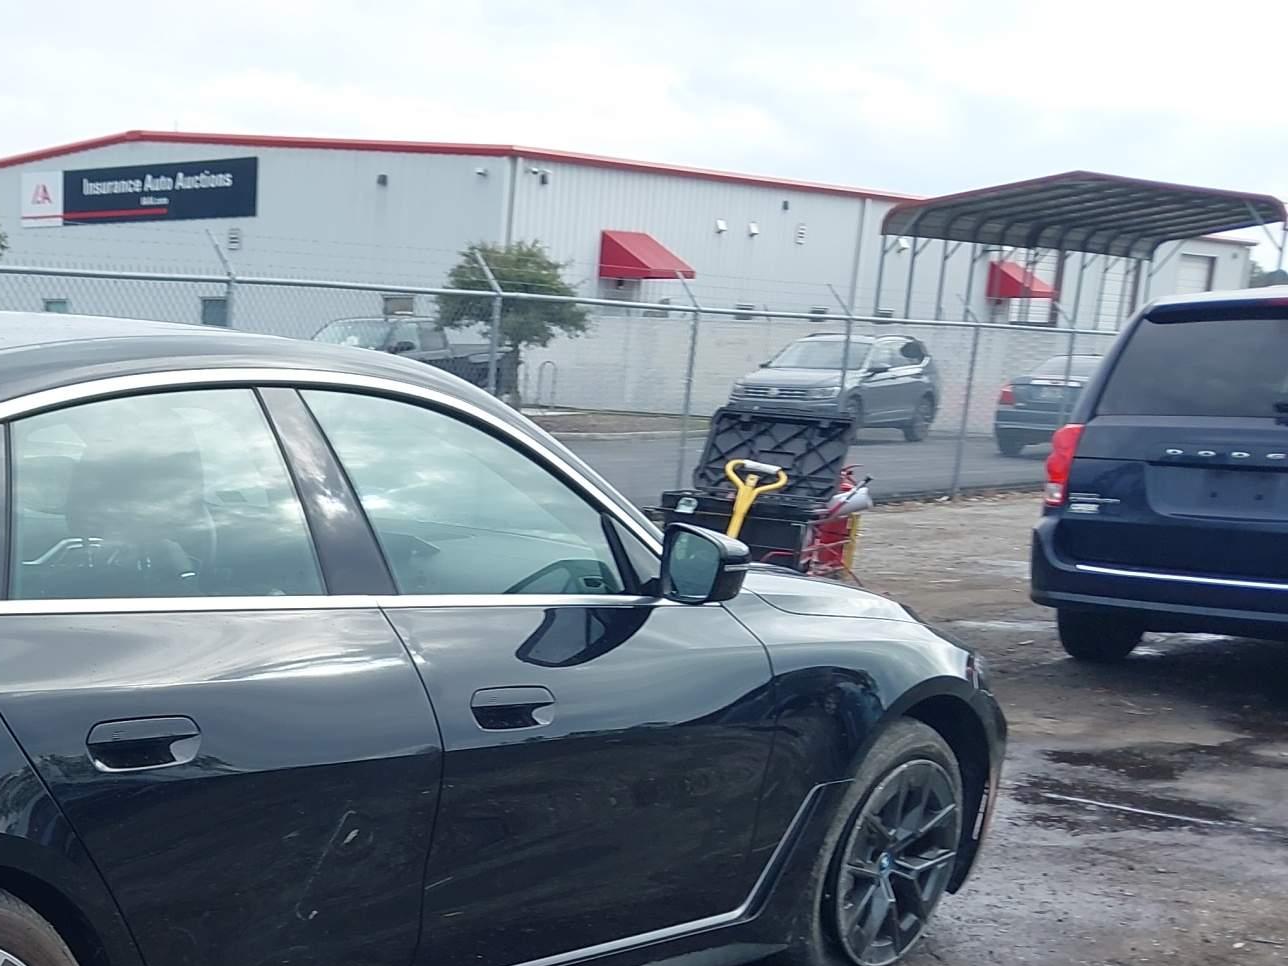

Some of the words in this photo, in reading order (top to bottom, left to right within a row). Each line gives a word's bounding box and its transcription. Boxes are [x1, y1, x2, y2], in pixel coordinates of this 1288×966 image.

[83, 178, 142, 196] Insurance
[144, 174, 174, 193] Auto
[175, 170, 233, 190] Auctions
